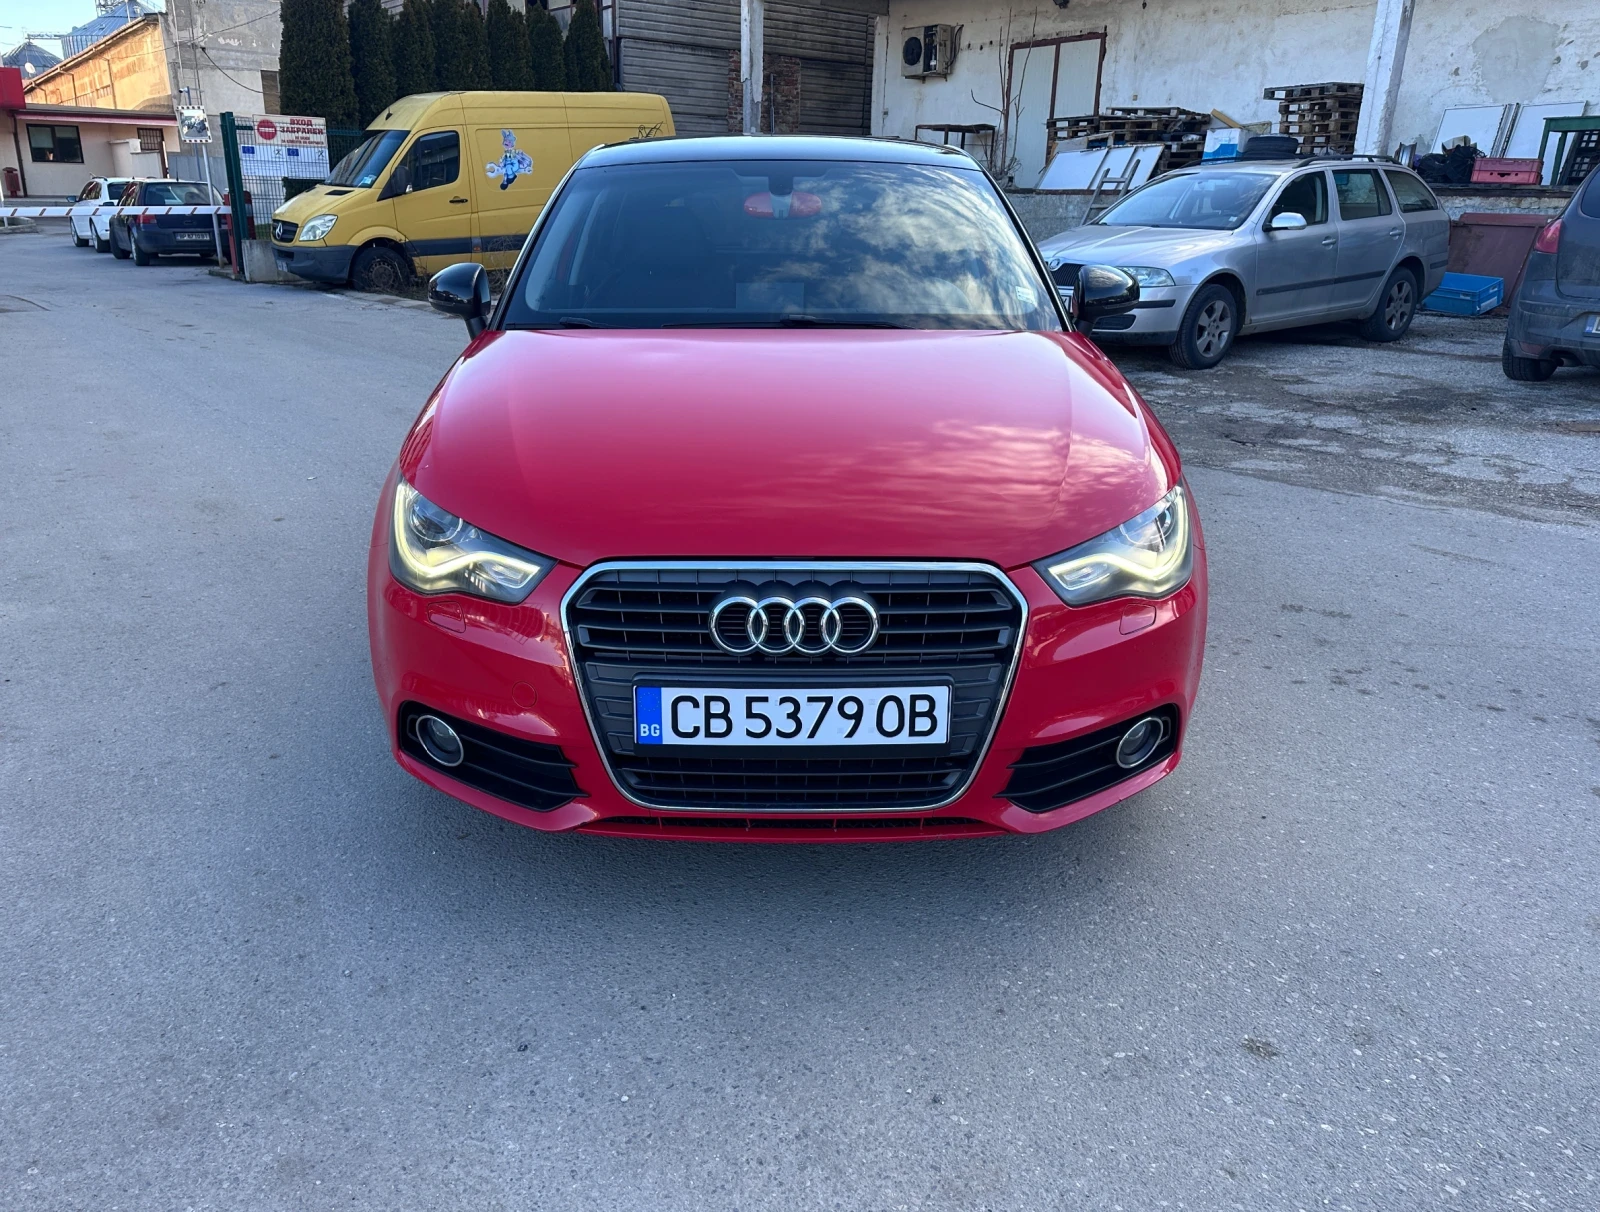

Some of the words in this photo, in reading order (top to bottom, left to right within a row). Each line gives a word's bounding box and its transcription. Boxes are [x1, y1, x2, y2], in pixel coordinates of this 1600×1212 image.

[290, 118, 313, 127] ВХОД
[280, 126, 324, 135] ЗАБРАНЕН
[670, 694, 733, 739] CB
[745, 695, 864, 739] 5379
[876, 693, 938, 738] OB
[640, 723, 660, 737] BG
